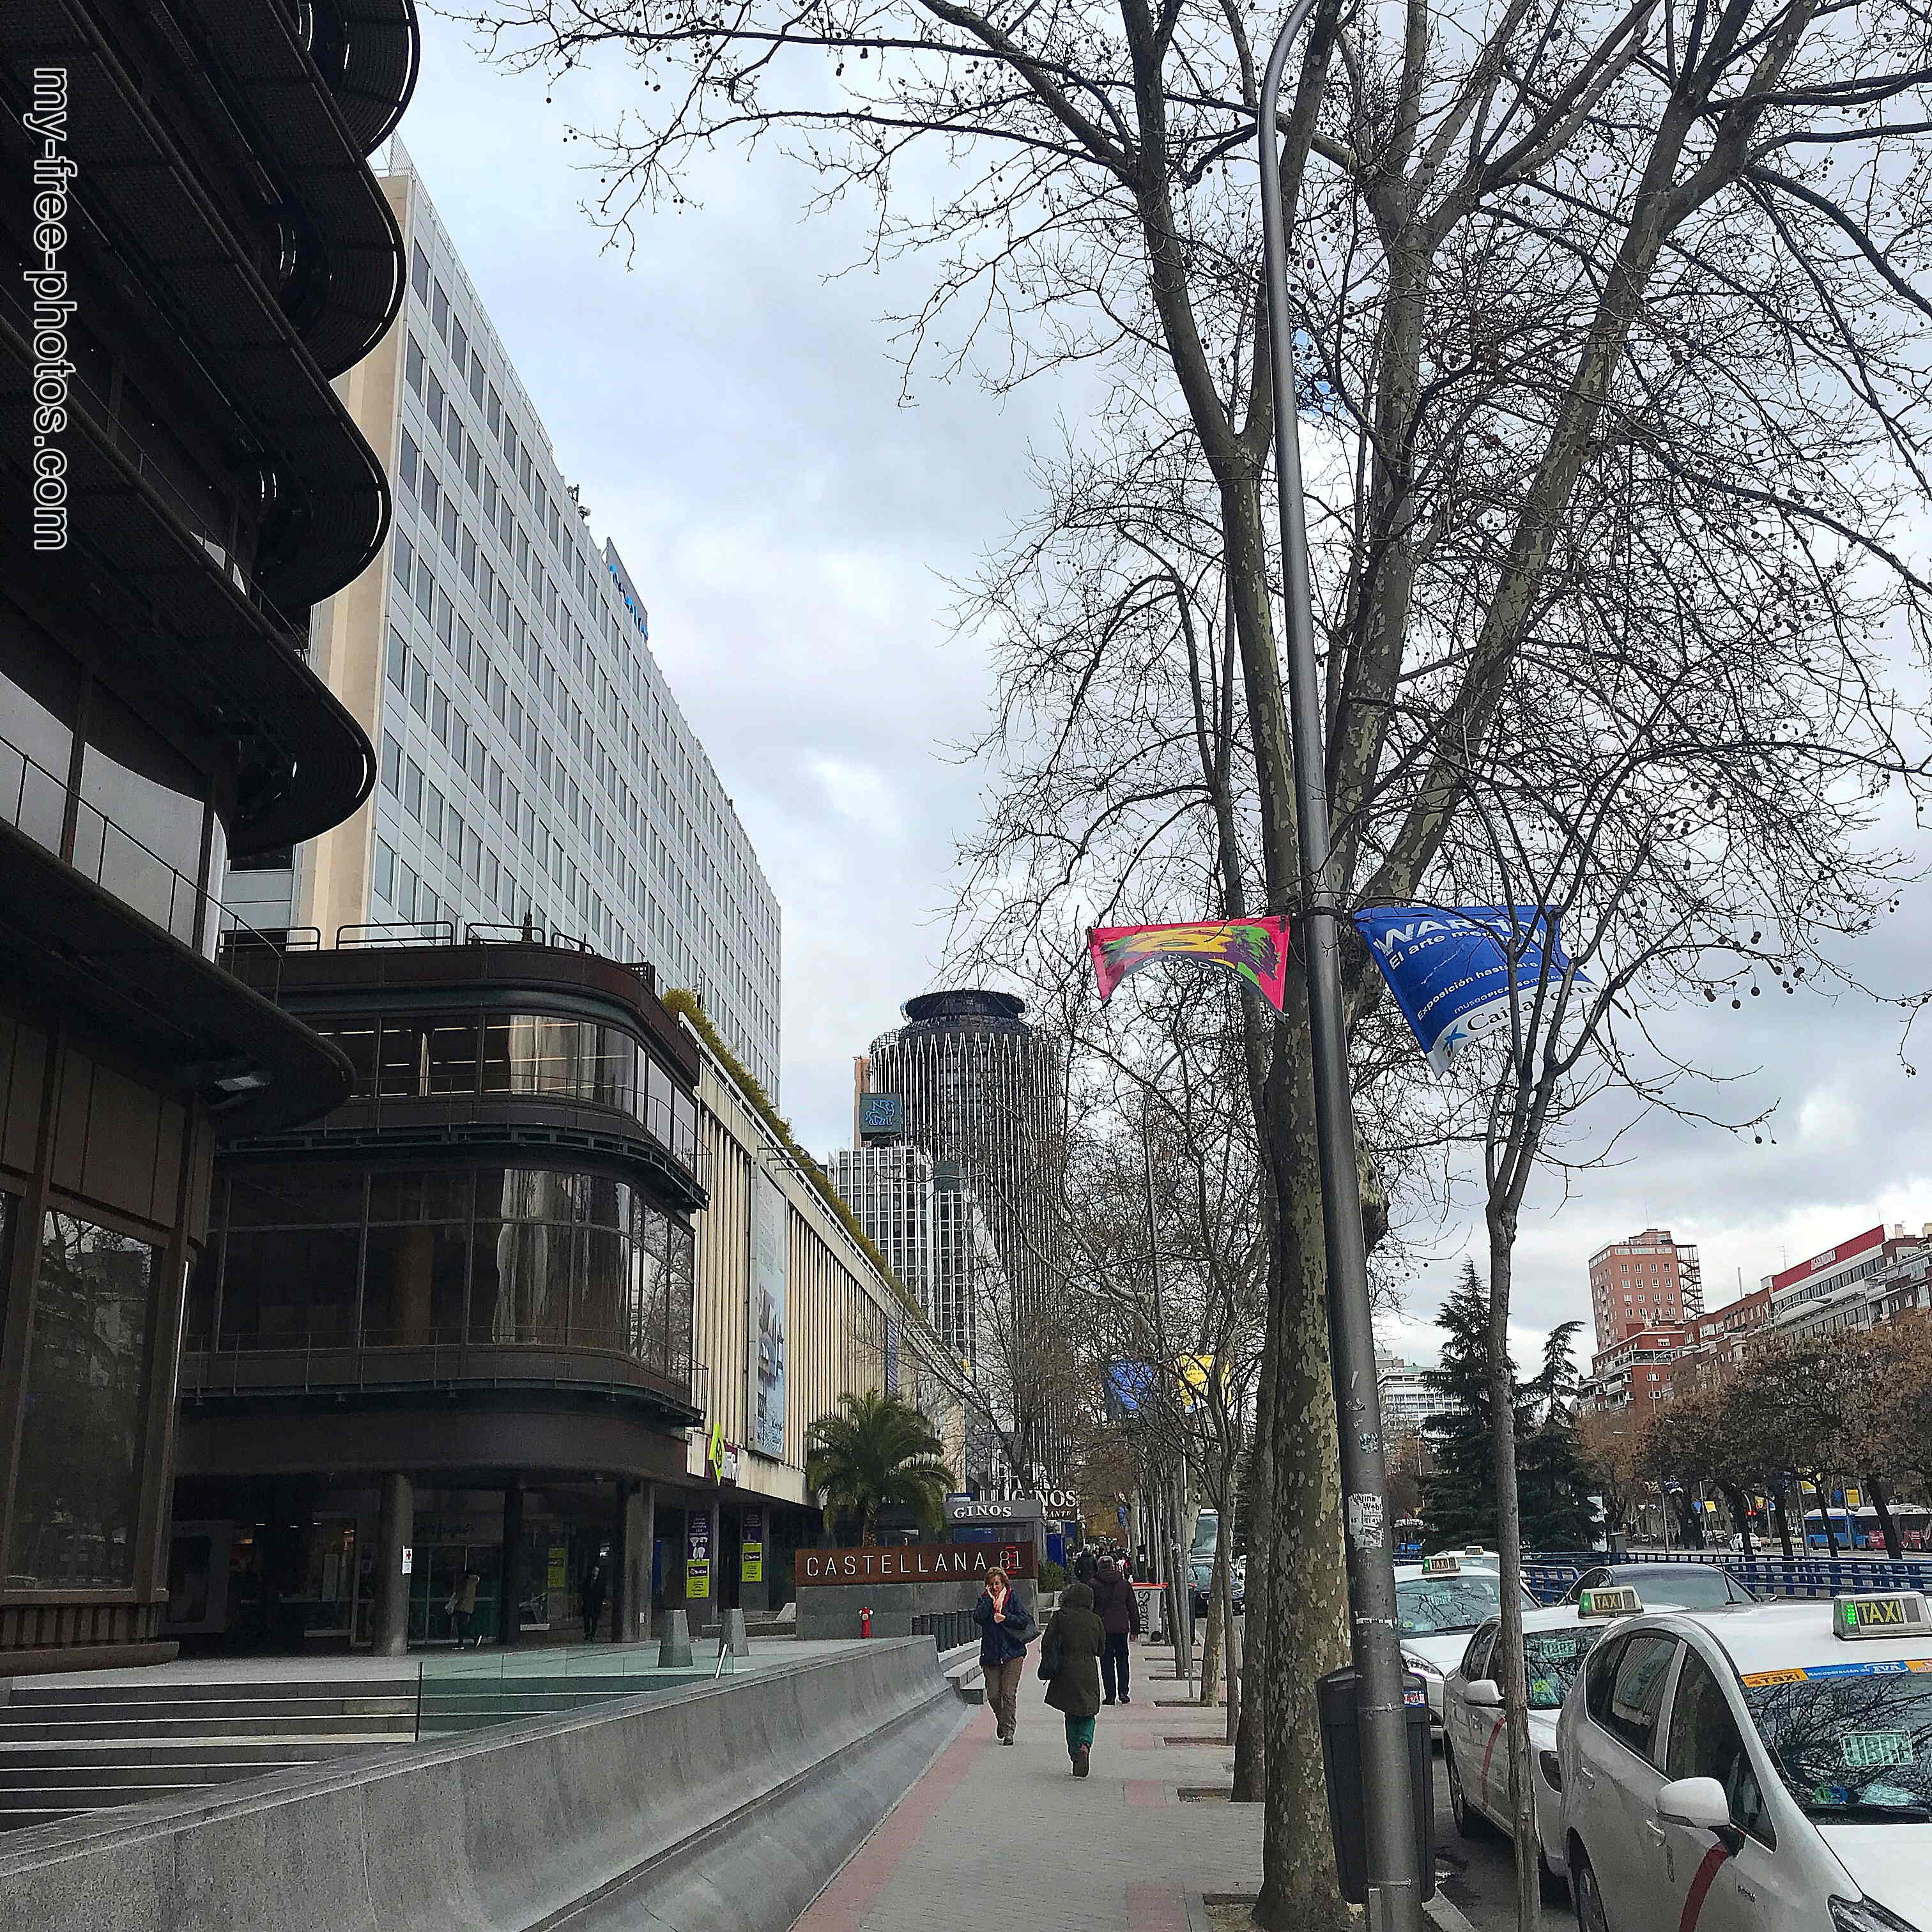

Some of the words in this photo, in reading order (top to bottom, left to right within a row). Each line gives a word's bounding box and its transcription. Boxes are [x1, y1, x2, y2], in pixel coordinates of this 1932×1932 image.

[1388, 951, 1404, 970] El
[1408, 935, 1445, 954] arte
[1417, 976, 1474, 1021] Exposición
[1011, 1489, 1077, 1507] GNOS
[953, 1505, 1013, 1519] GINOS
[807, 1551, 986, 1576] CASTELLANA
[999, 1551, 1023, 1569] 81
[1432, 1559, 1448, 1569] TAXI
[1597, 1593, 1620, 1609] TAXI
[1857, 1600, 1903, 1625] TAXI
